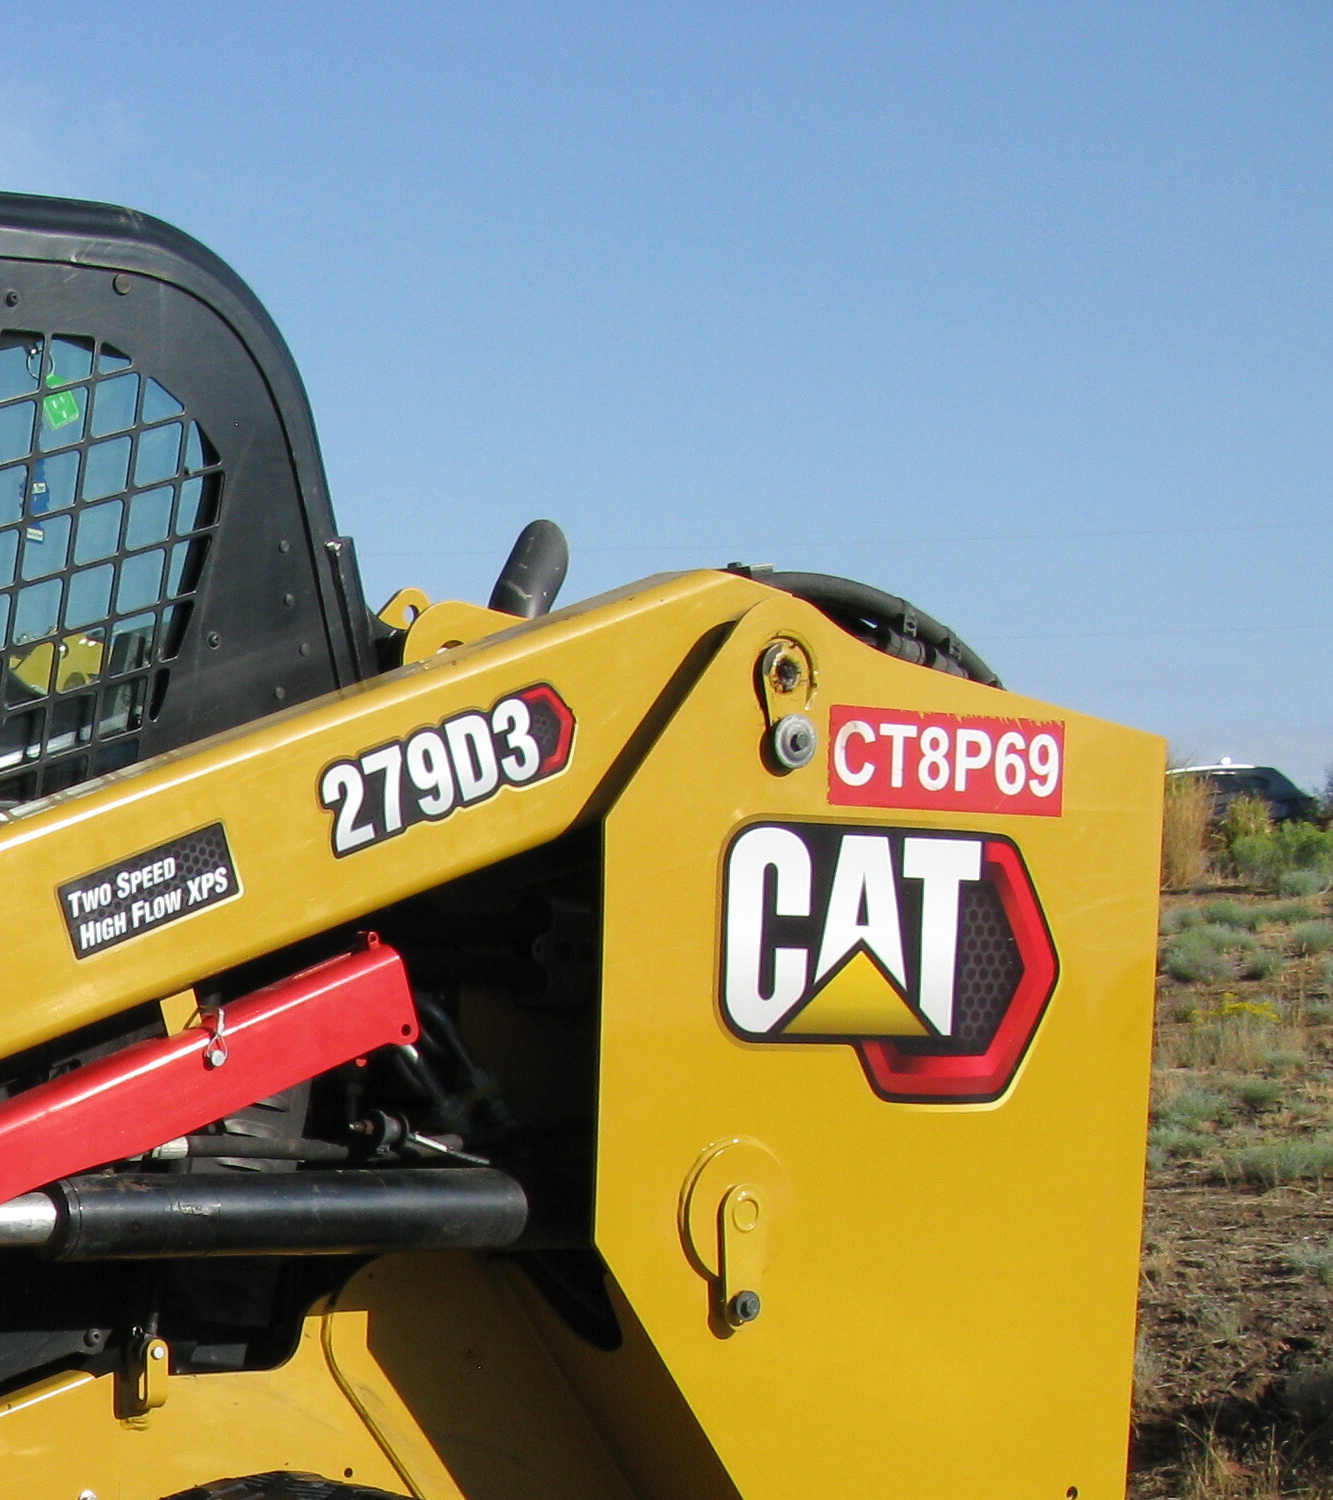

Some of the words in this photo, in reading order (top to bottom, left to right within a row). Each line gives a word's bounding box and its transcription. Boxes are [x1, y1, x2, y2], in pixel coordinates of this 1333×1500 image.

[321, 697, 541, 853] 279D3
[833, 719, 1060, 798] CT8P69
[186, 866, 228, 906] XPS
[724, 826, 983, 1037] CAT
